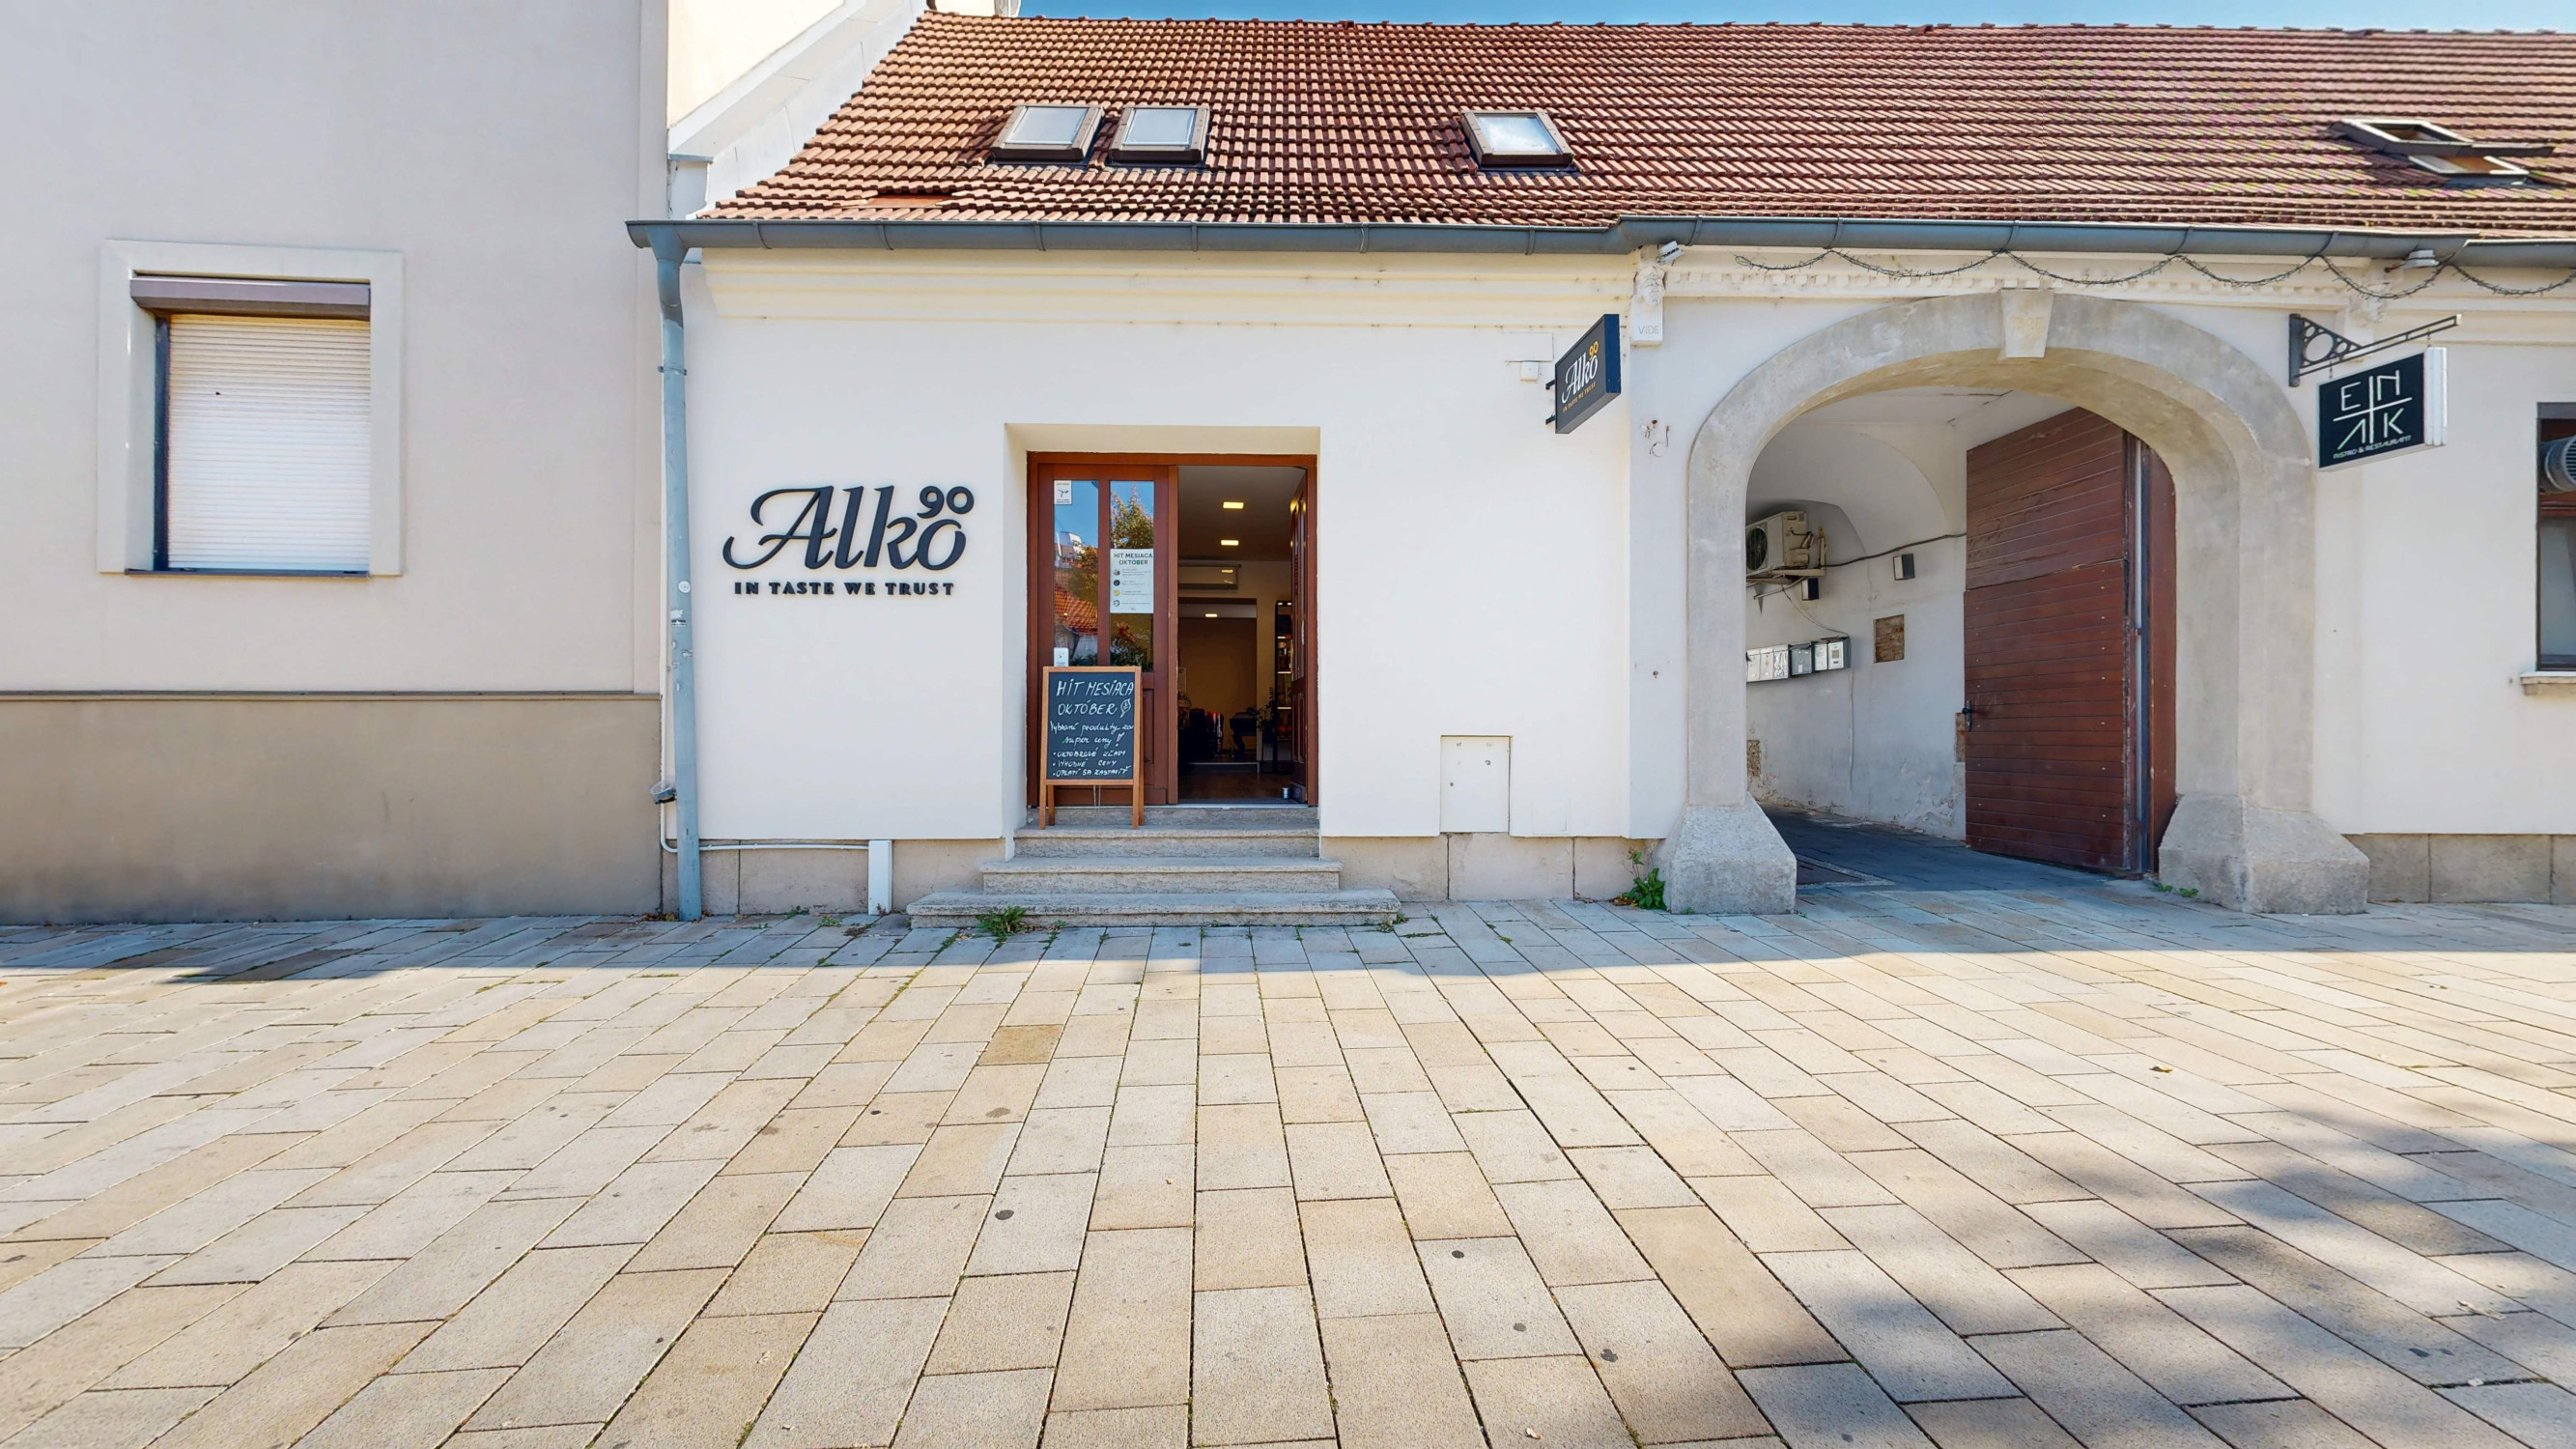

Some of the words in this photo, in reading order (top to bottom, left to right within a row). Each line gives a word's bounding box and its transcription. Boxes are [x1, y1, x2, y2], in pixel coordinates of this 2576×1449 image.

[1637, 325, 1659, 334] VIDE
[1561, 352, 1599, 404] Alko
[1589, 341, 1599, 360] 90
[722, 485, 967, 570] Alko
[917, 485, 975, 519] 90
[734, 582, 759, 595] IN
[769, 582, 835, 595] TASTE
[843, 582, 876, 596] WE
[885, 582, 954, 596] TRUST
[1058, 699, 1118, 716] OKTÓBER
[1081, 723, 1120, 736] produkty
[1062, 736, 1090, 747] super
